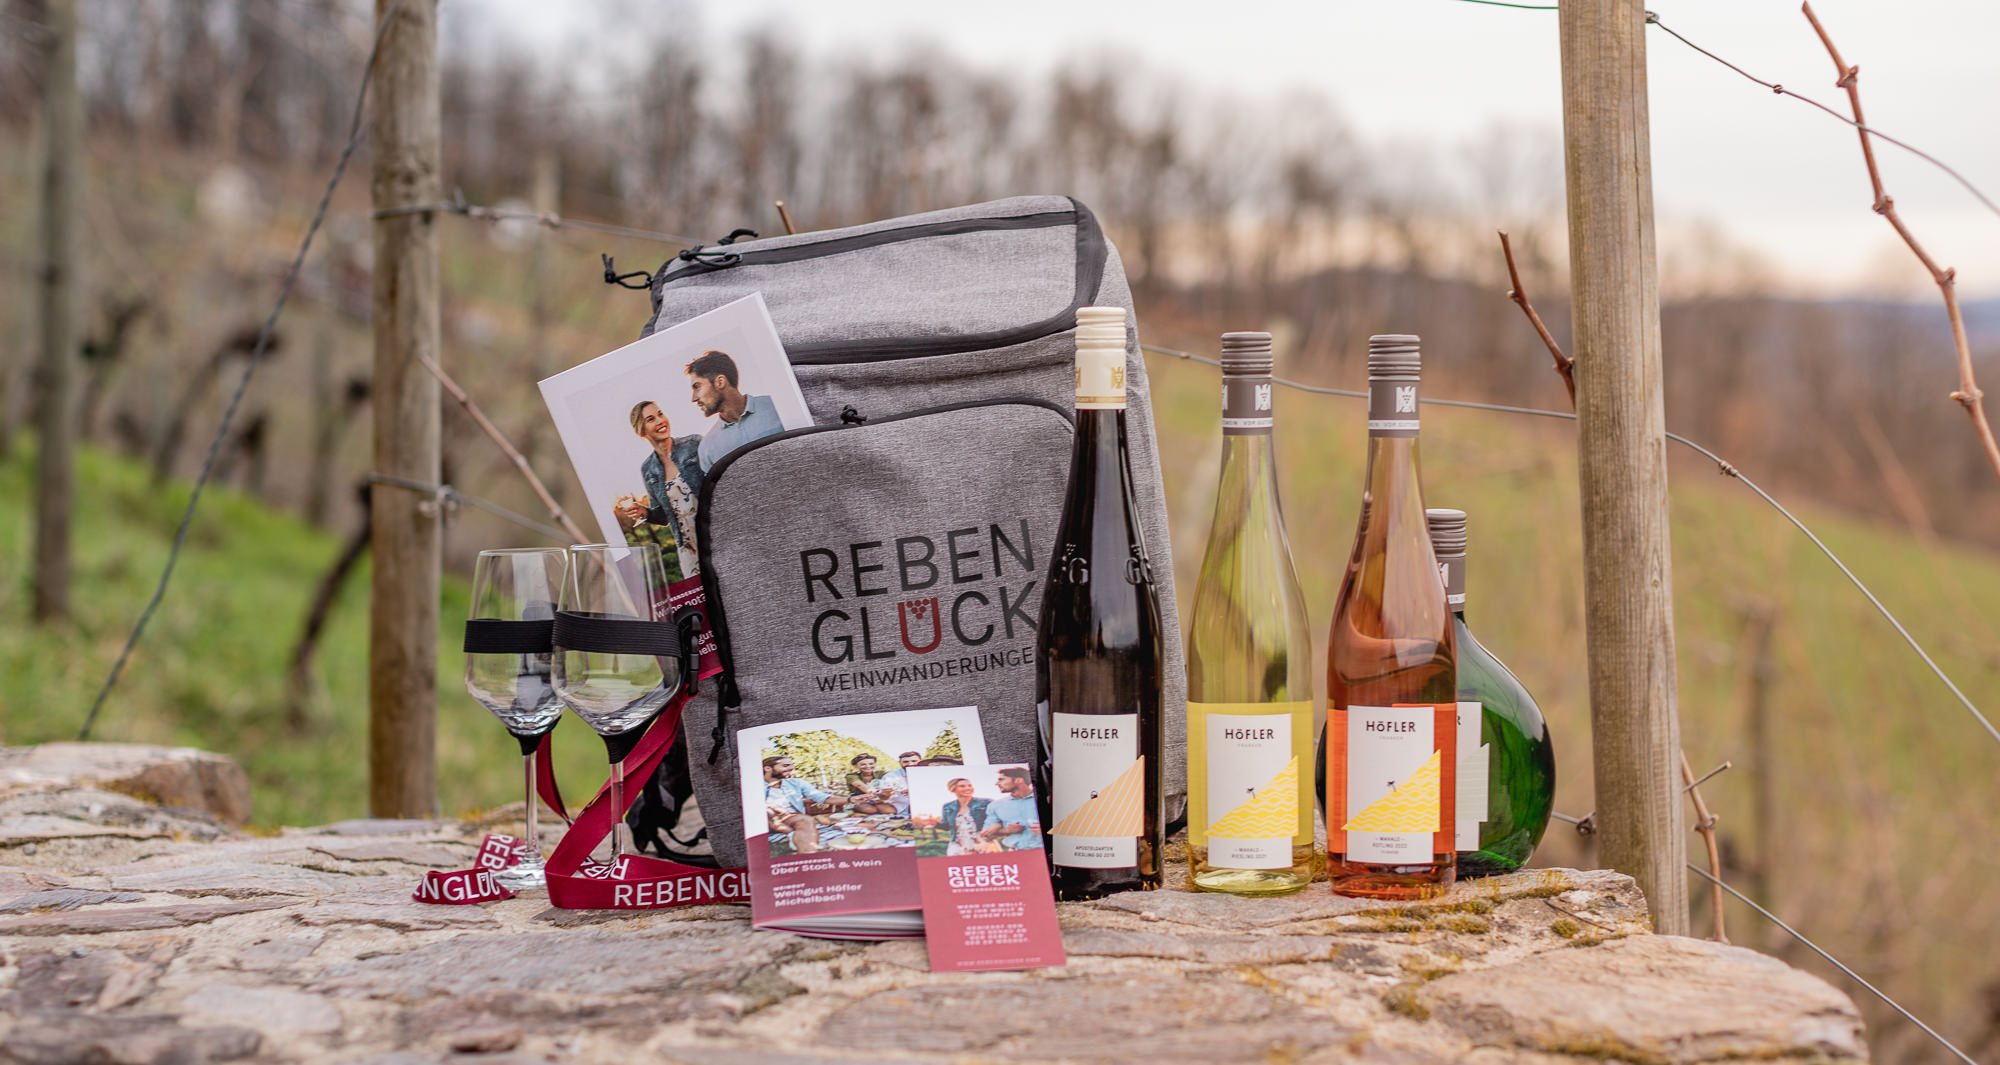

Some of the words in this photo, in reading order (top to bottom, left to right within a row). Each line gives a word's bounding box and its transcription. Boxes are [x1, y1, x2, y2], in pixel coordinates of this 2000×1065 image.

[800, 519, 1035, 603] REBEN
[816, 647, 1033, 692] WEINWANDERUNGE
[802, 863, 835, 872] Stock
[838, 861, 850, 869] &
[852, 859, 882, 868] Wein
[947, 864, 1018, 878] REBEN
[773, 886, 824, 898] Weingut
[826, 884, 862, 892] Höfler
[775, 893, 845, 907] Michelbach
